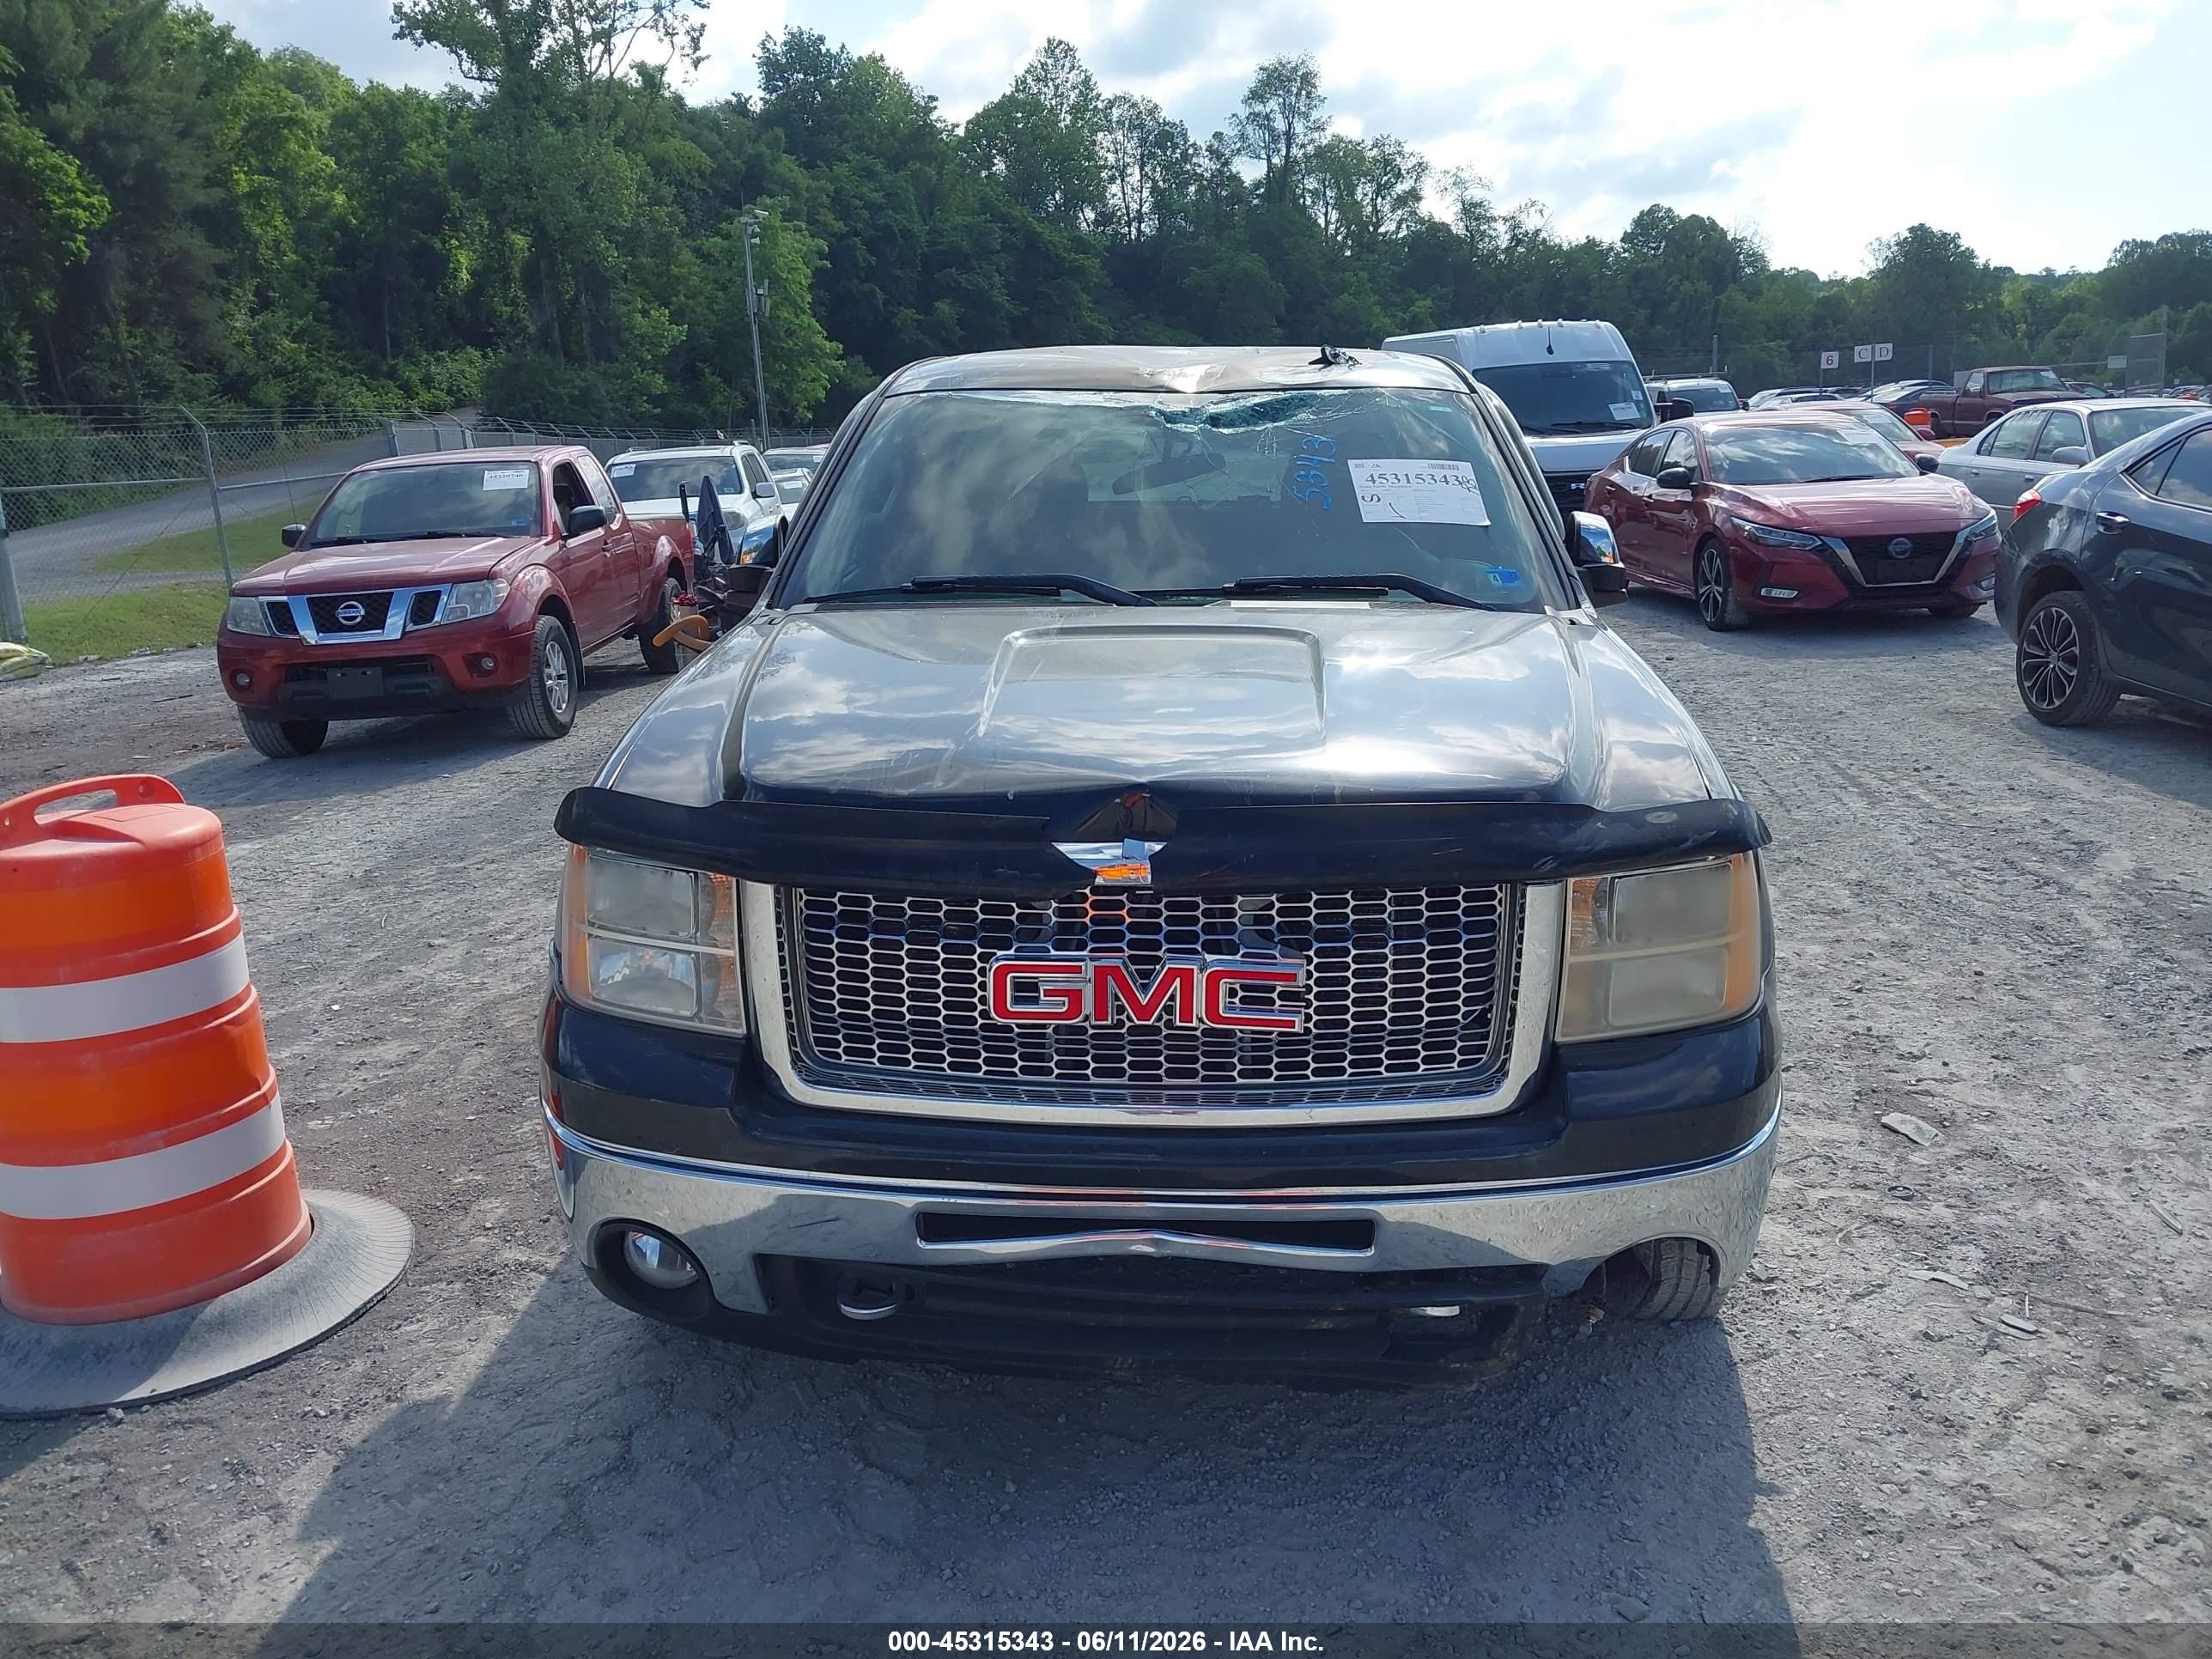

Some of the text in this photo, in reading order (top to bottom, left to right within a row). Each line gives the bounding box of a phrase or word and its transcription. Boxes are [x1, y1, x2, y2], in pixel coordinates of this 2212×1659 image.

[1858, 346, 1889, 359] C D
[1826, 355, 1834, 365] 6
[1292, 436, 1337, 509] 5343
[1365, 472, 1462, 486] 45315343
[988, 951, 1306, 1034] GMC
